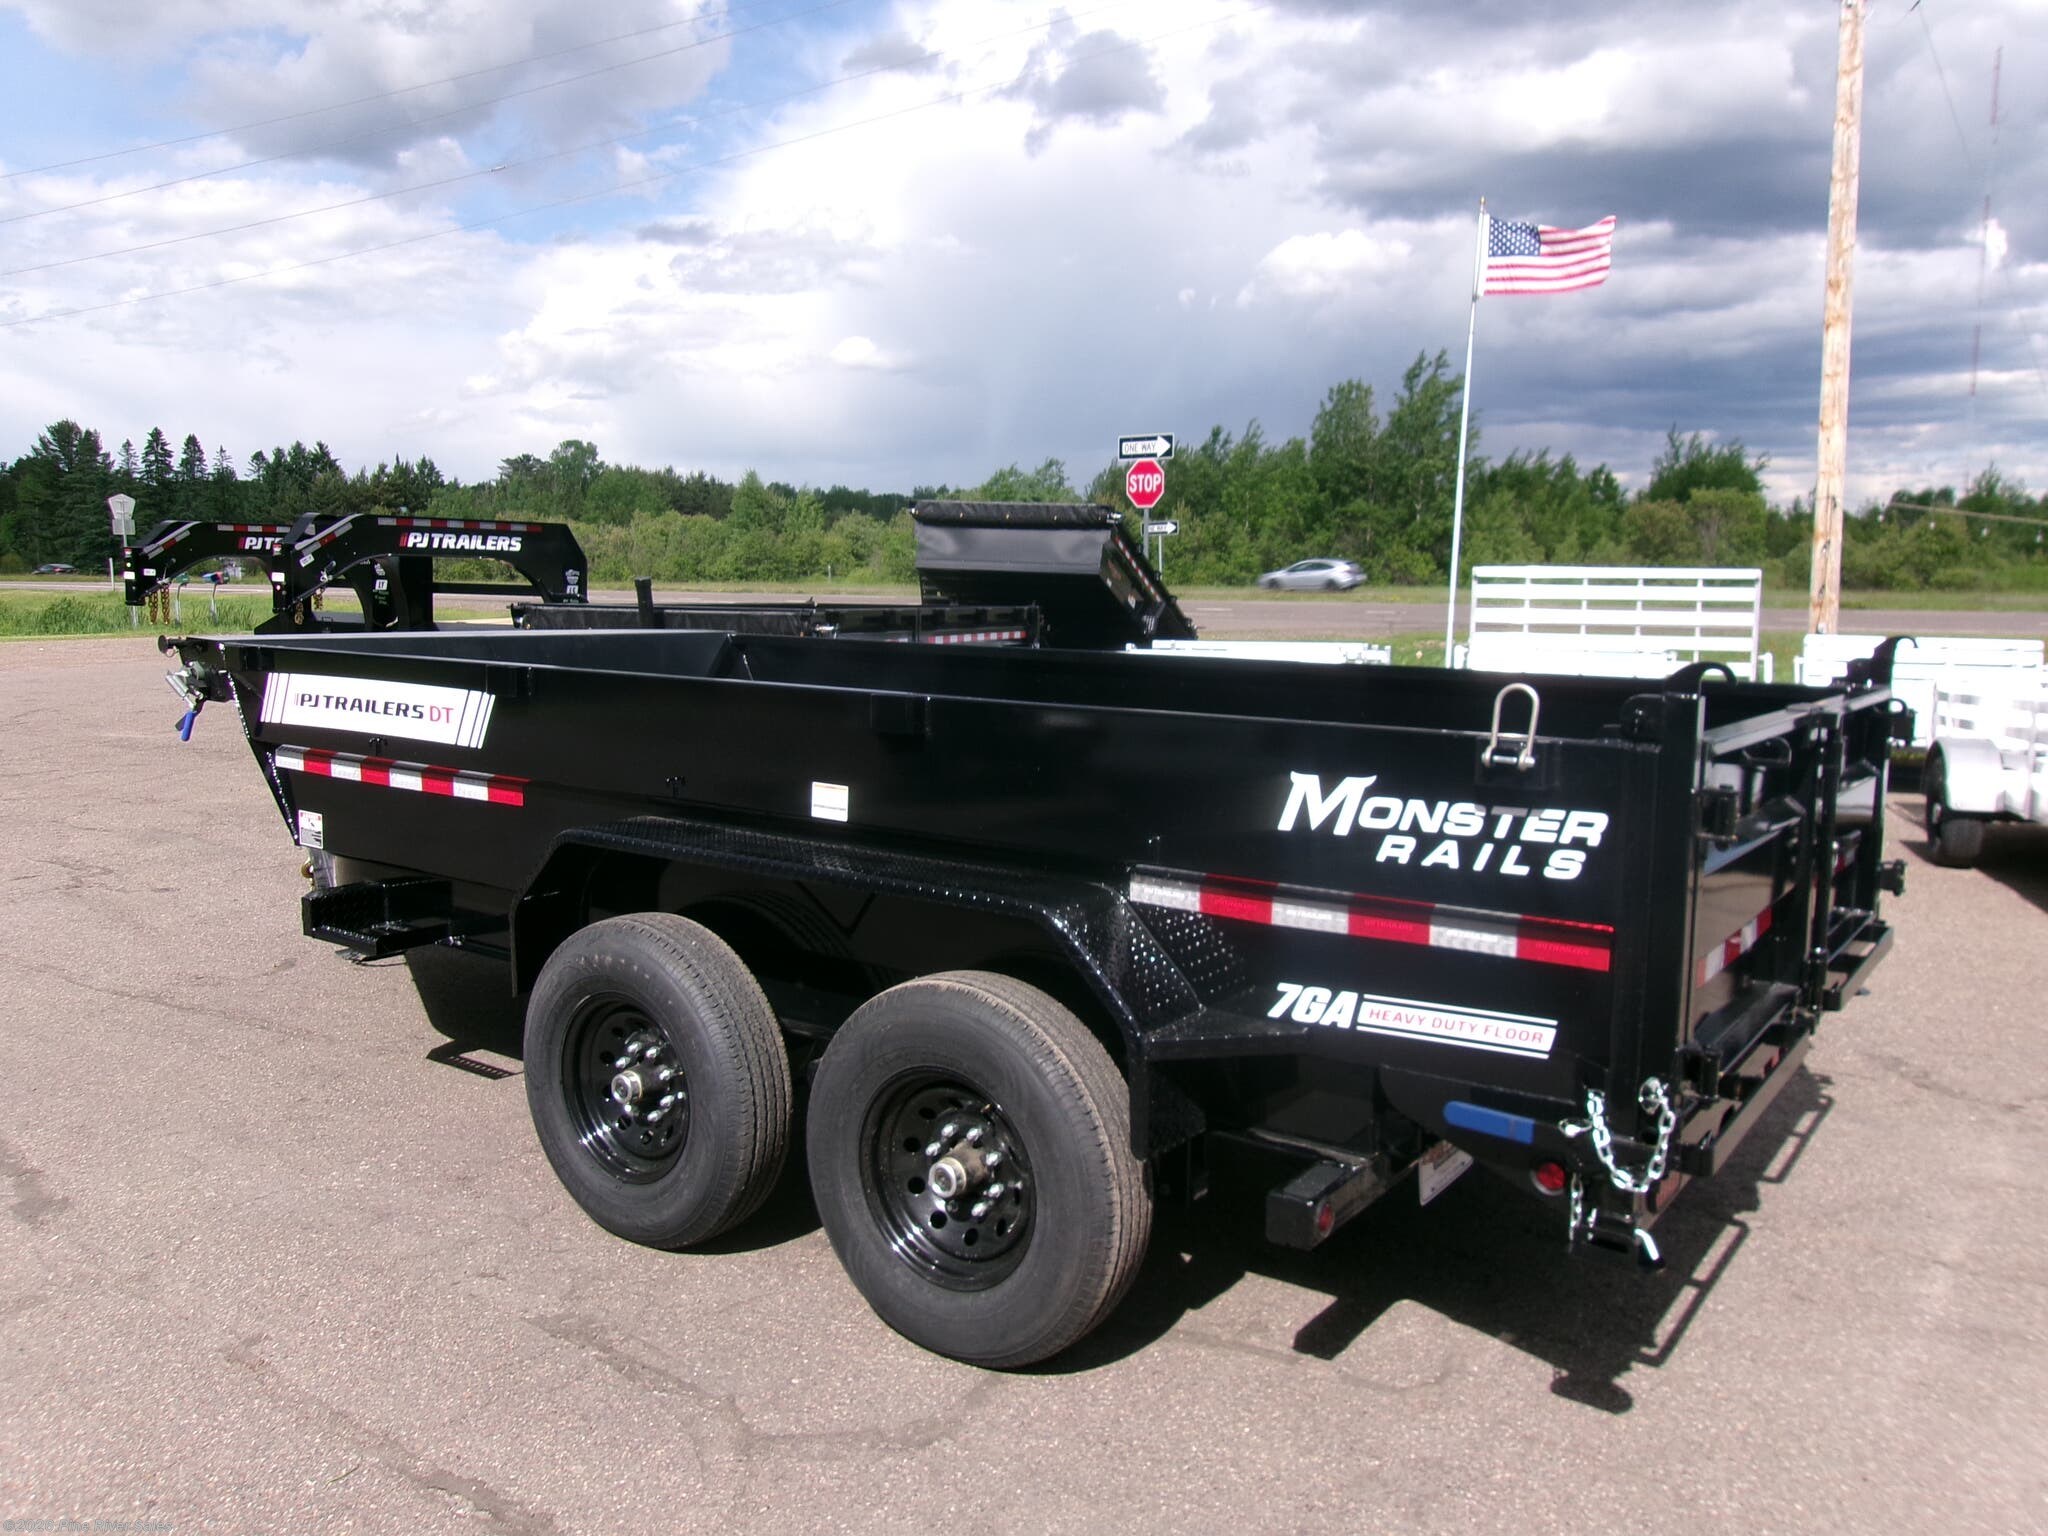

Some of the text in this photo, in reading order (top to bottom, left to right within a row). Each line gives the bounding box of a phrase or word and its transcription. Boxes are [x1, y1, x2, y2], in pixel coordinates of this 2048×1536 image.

[1124, 443, 1157, 454] ONE WAY
[1129, 473, 1161, 494] STOP
[244, 536, 264, 550] PJ
[407, 532, 522, 552] PJ TRAILERS
[299, 692, 455, 724] PJ TRAILERS DT
[1277, 770, 1610, 847] MONSTER
[1375, 834, 1587, 880] RAILS
[1267, 982, 1544, 1044] 7GA HEAVY DUTY FLOOR
